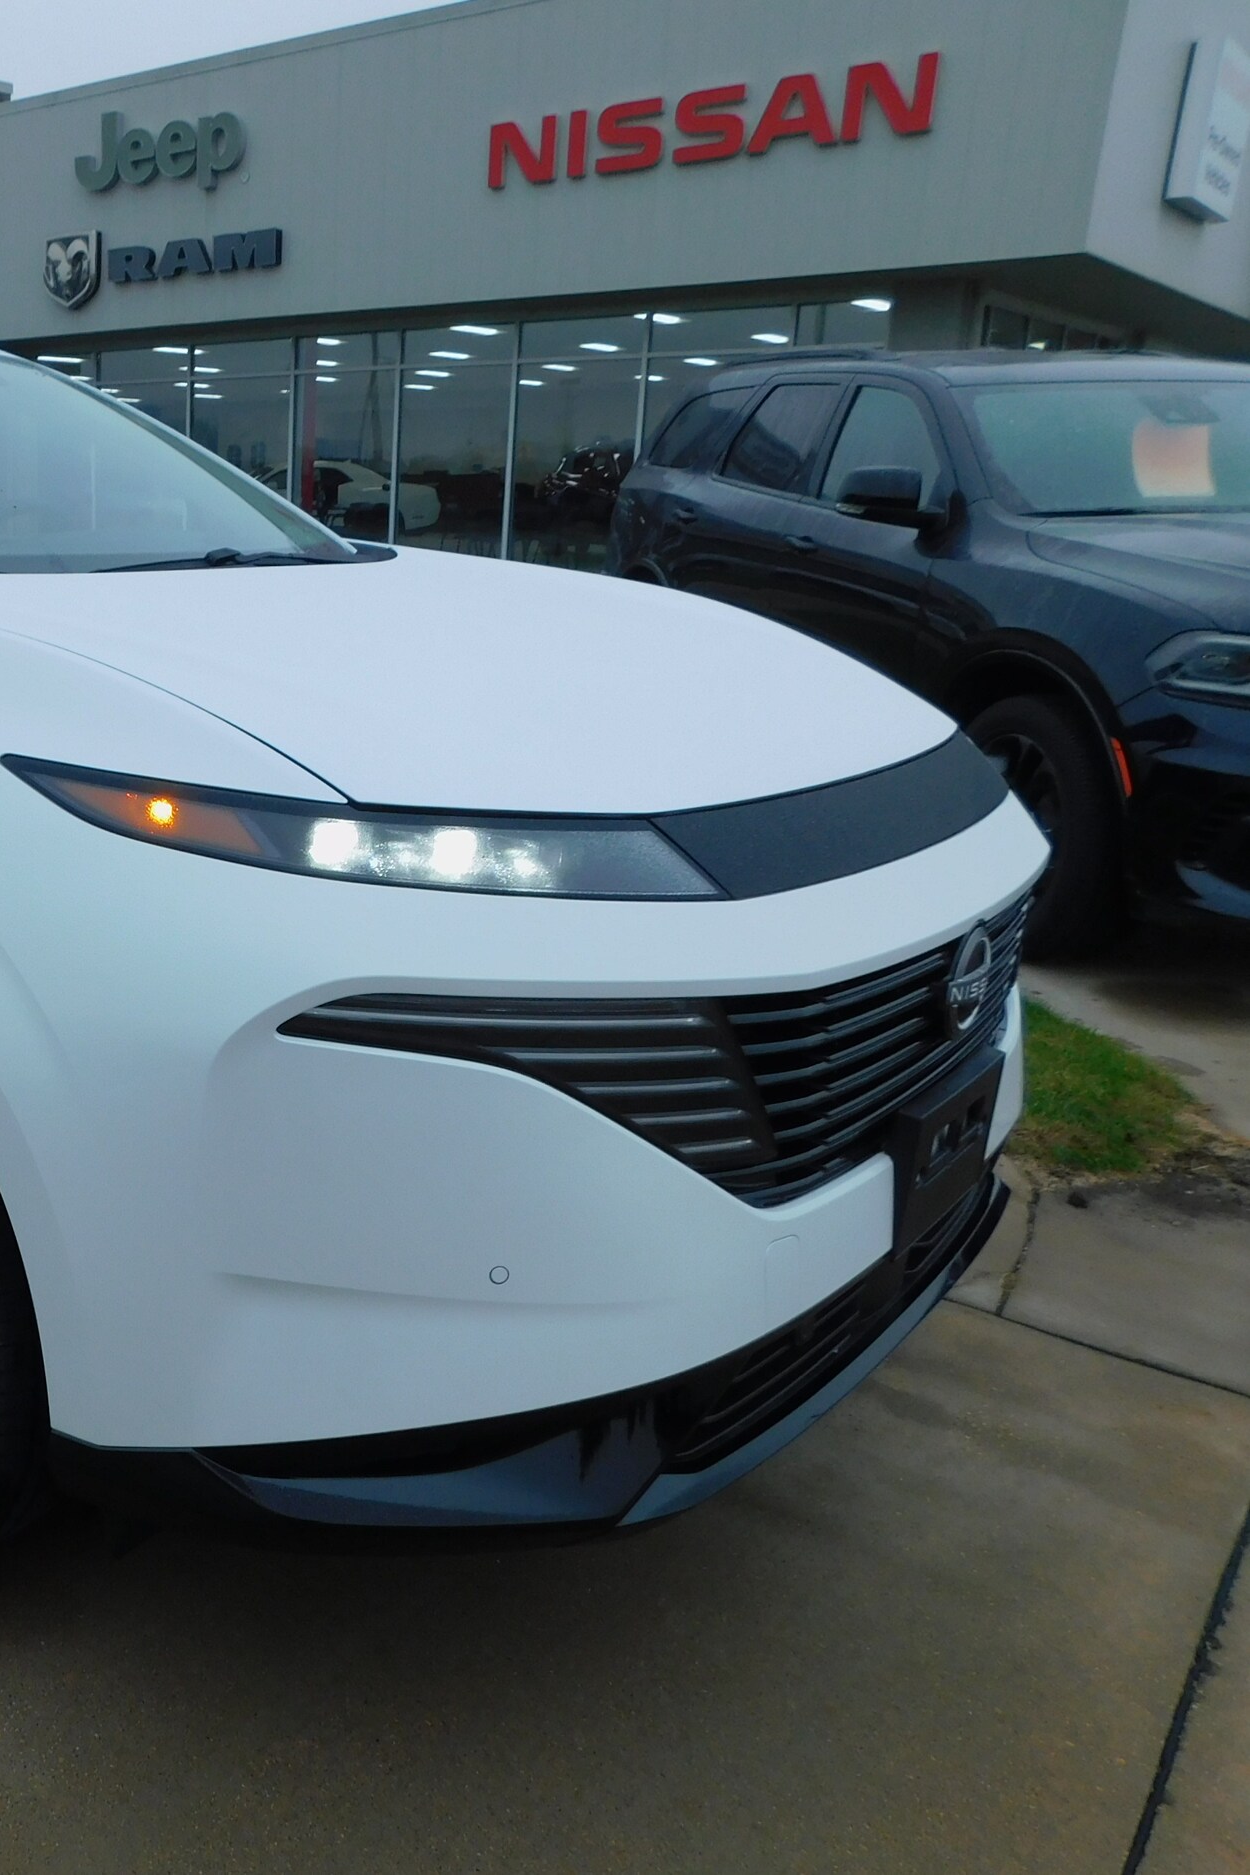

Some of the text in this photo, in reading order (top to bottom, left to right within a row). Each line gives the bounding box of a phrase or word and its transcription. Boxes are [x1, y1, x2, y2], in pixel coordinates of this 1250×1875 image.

[74, 110, 247, 192] Jeep
[487, 51, 940, 190] NISSAN
[107, 227, 283, 285] RAM
